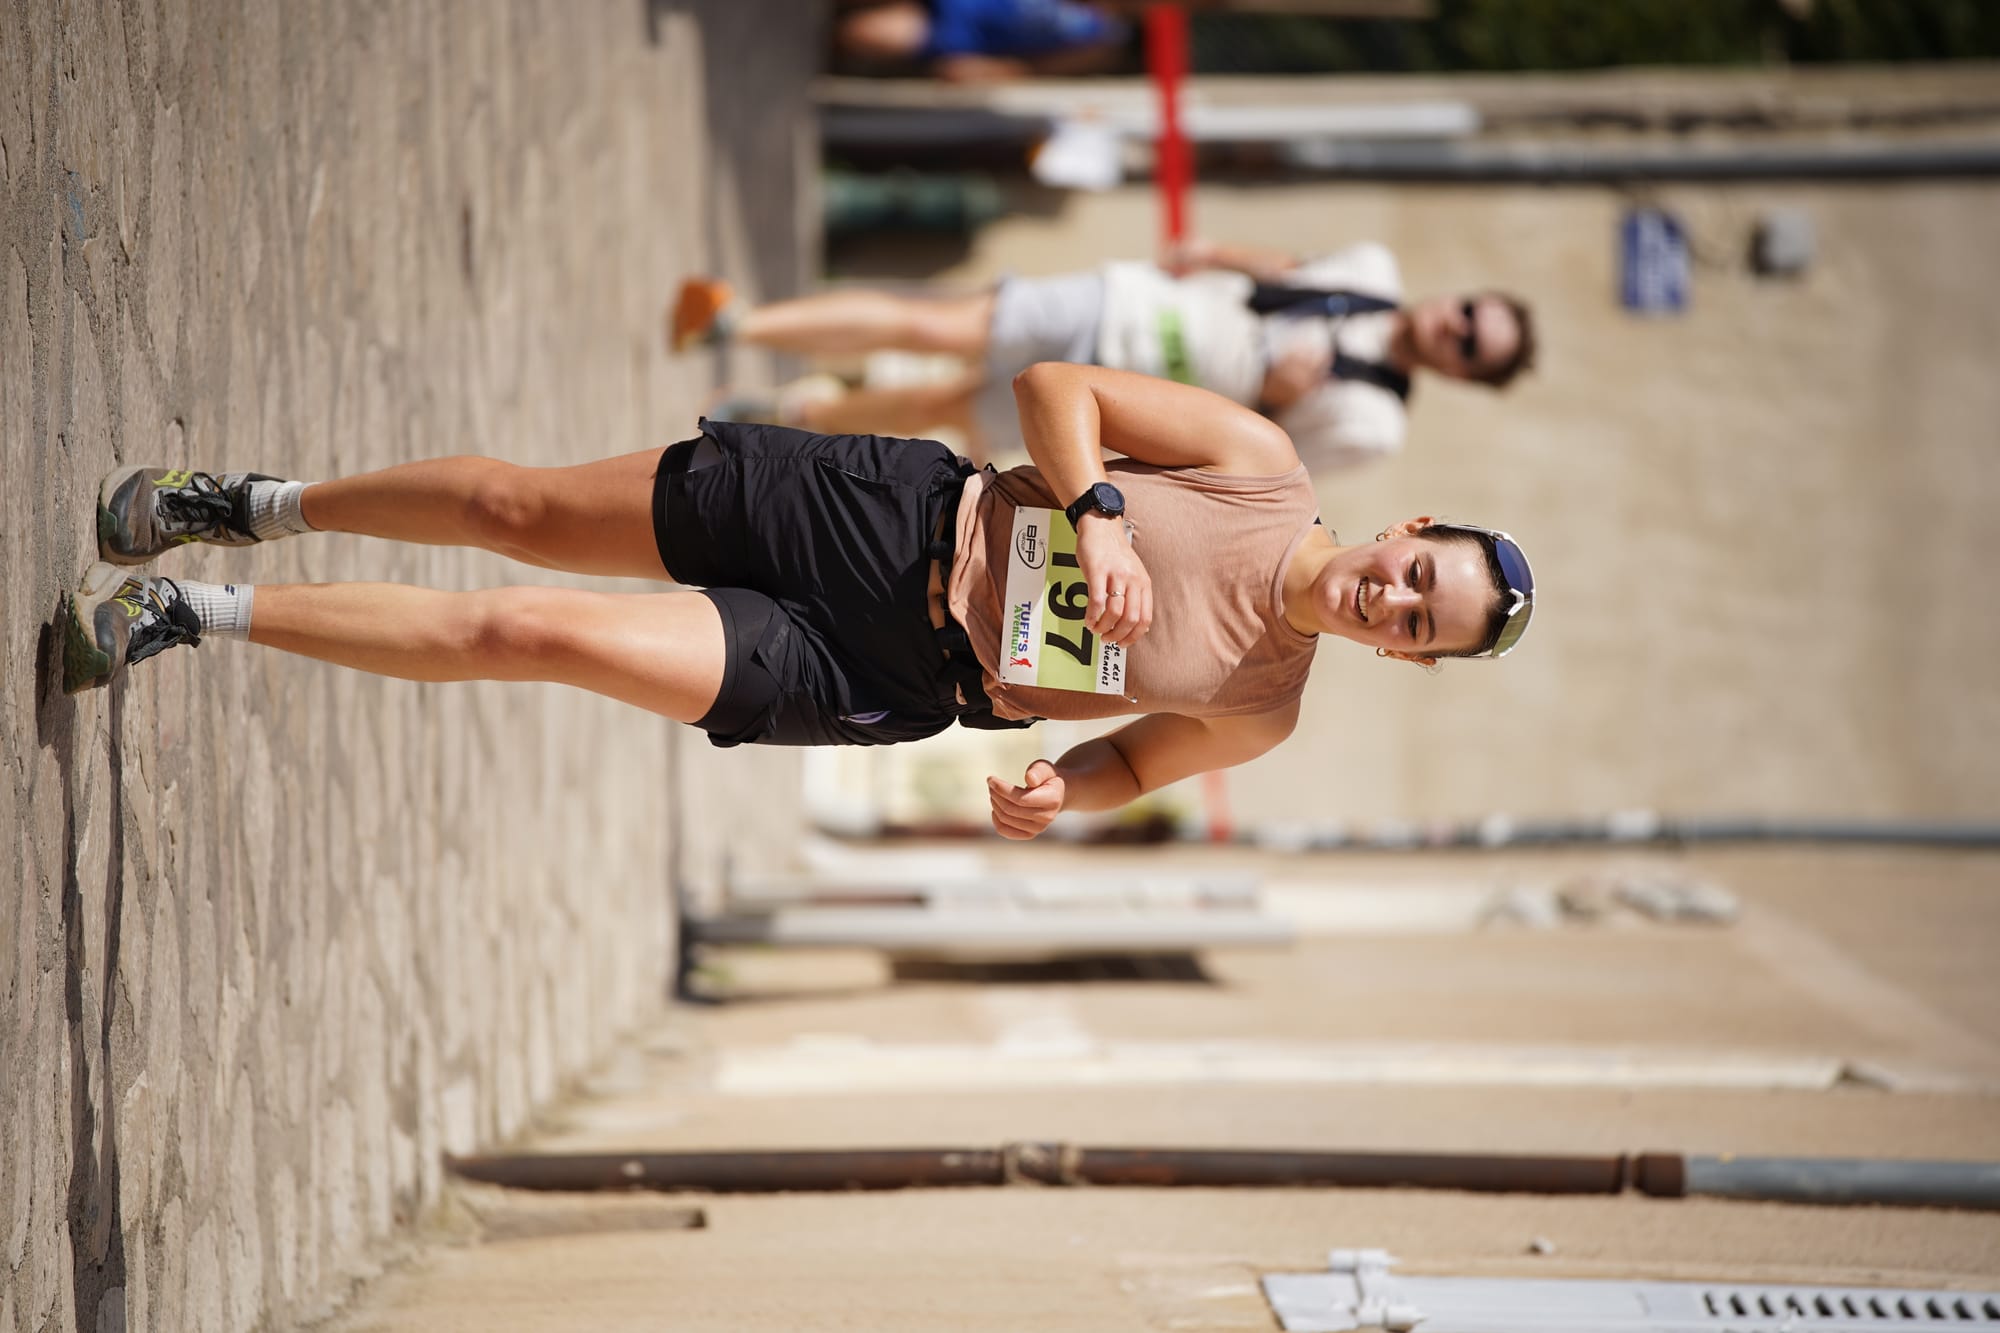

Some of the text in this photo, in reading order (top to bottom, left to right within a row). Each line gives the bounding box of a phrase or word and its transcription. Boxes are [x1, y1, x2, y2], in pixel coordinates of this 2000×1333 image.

[1025, 525, 1037, 563] BFP
[1010, 604, 1024, 657] Aventure
[1018, 601, 1031, 652] TUFF'S
[1045, 552, 1093, 666] 197
[1102, 643, 1113, 686] évenoles
[1112, 664, 1121, 682] des
